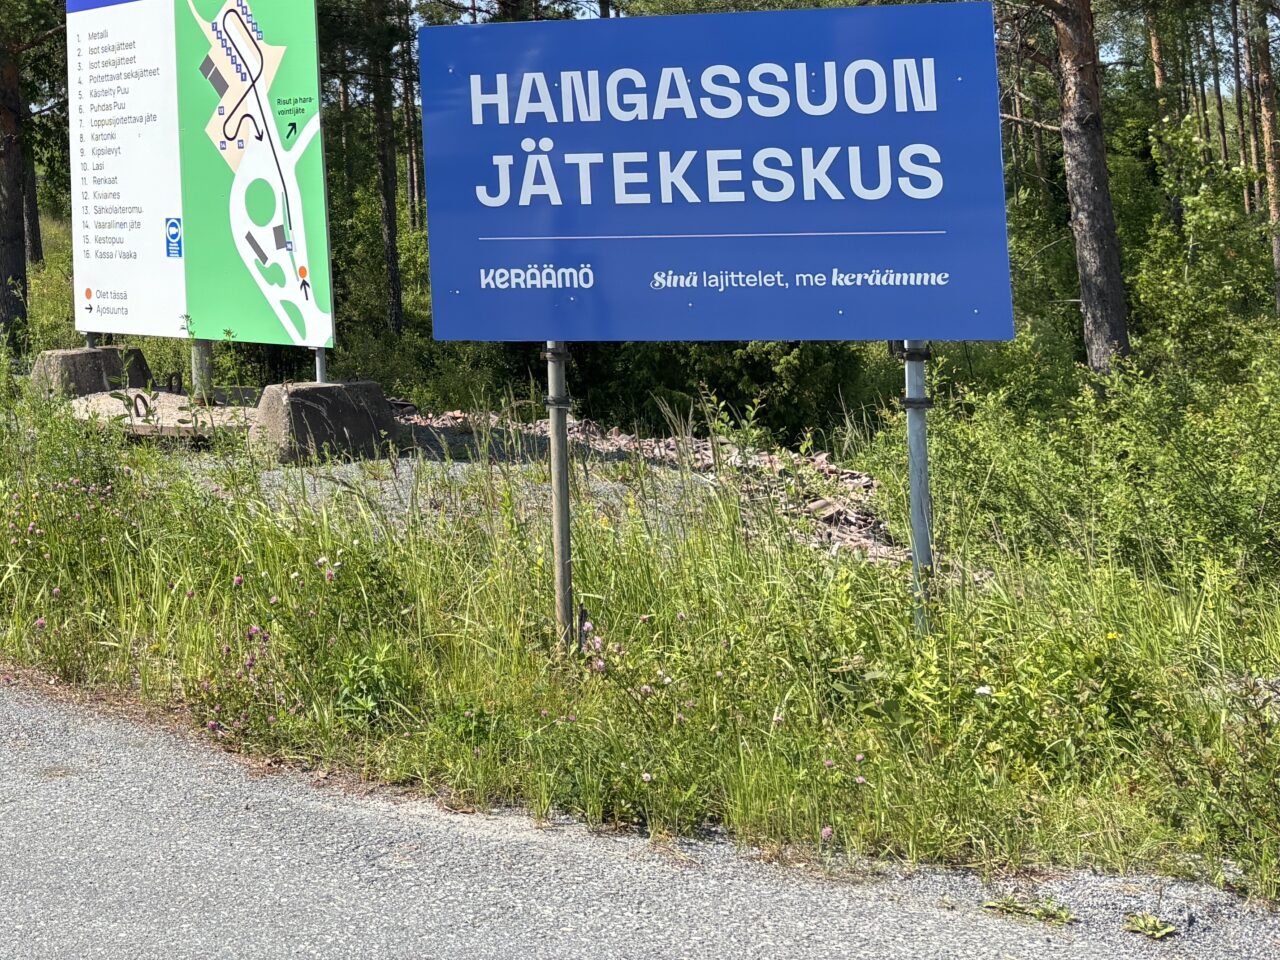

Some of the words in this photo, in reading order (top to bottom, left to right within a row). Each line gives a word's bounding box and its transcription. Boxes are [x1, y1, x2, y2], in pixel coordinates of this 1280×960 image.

[88, 30, 108, 40] Metalli
[77, 48, 82, 56] 2.
[88, 46, 100, 55] Isot
[100, 40, 136, 54] sekajätteet
[78, 62, 83, 71] 3.
[89, 60, 100, 70] Isot
[101, 55, 136, 68] sekajätteet
[123, 67, 160, 80] sekajätteet
[78, 91, 84, 100] 5.
[116, 86, 130, 96] Puu
[469, 58, 938, 125] HANGASSUON
[276, 98, 292, 106] Risut
[292, 96, 298, 106] ja
[79, 105, 84, 114] 6.
[90, 102, 112, 113] Puhdas
[114, 101, 126, 110] Puu
[278, 106, 306, 116] vointijäte
[90, 114, 144, 128] Loppusijoitettava
[144, 112, 158, 124] jäte
[80, 134, 86, 142] 8.
[90, 132, 116, 142] Kartonki
[80, 148, 86, 157] 9.
[92, 146, 122, 157] Kipsilevyt
[81, 162, 90, 172] 10.
[92, 161, 104, 170] Lasi
[475, 137, 944, 207] JÄTEKESKUS
[92, 176, 118, 185] Renkaat
[82, 192, 90, 200] 12.
[93, 191, 120, 200] Kiviaines
[82, 206, 90, 215] 13.
[94, 205, 142, 215] Sähkölaiteromu
[94, 220, 128, 230] Vaarallinen
[128, 220, 141, 232] jäte
[83, 235, 91, 244] 15.
[94, 235, 124, 246] Kestopuu
[95, 250, 114, 259] Kassa
[118, 250, 138, 260] Vaaka
[650, 271, 699, 290] Sinä
[702, 270, 790, 292] lajittelet,
[795, 273, 827, 286] me
[830, 268, 950, 287] keräämme
[96, 290, 108, 300] Olet
[110, 290, 128, 300] tässä
[96, 304, 129, 316] Ajosuunta
